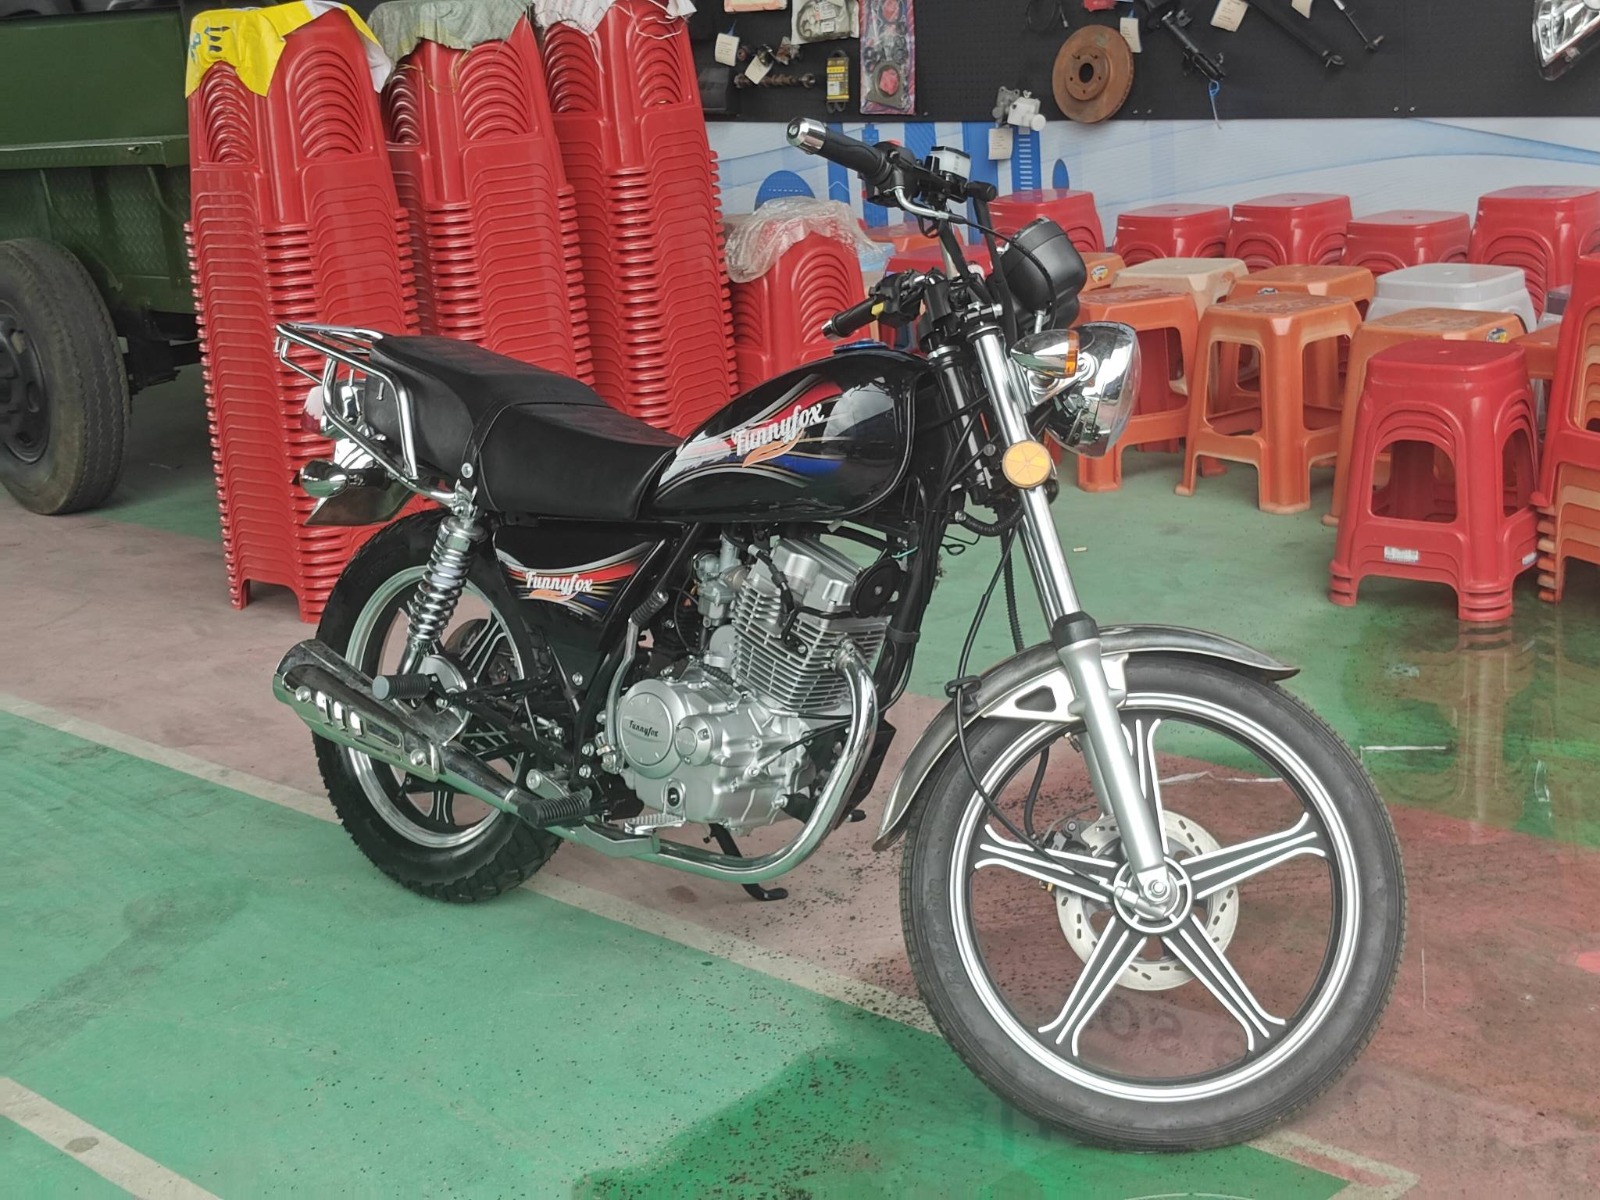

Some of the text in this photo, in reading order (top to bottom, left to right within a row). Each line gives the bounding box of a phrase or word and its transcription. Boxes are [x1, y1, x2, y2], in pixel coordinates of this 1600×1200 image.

[731, 403, 825, 456] Funnyfox
[525, 571, 593, 596] Funnyfox
[629, 720, 659, 738] Funnyfox
